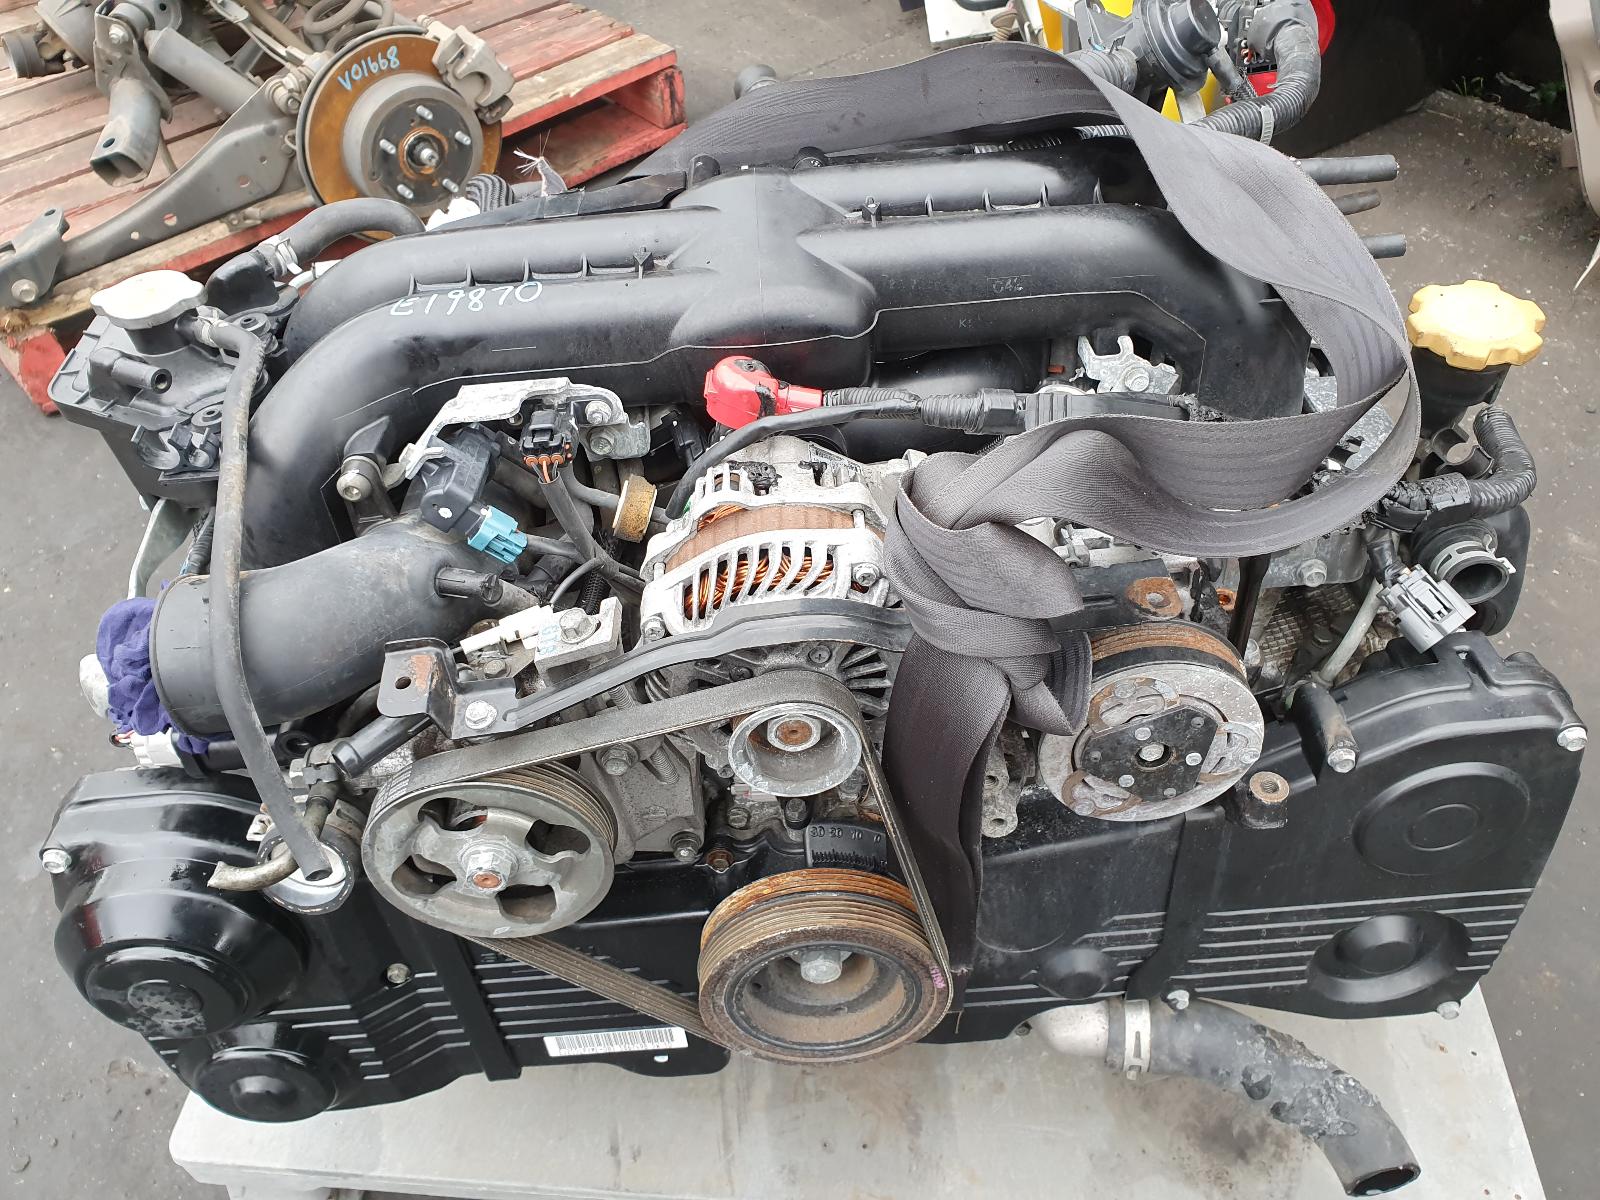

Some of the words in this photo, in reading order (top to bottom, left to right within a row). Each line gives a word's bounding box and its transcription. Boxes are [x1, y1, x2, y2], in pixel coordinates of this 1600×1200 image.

[337, 45, 400, 91] V01668
[390, 281, 543, 316] E19870
[810, 825, 825, 838] 30
[828, 826, 843, 839] 20
[851, 829, 863, 841] 10
